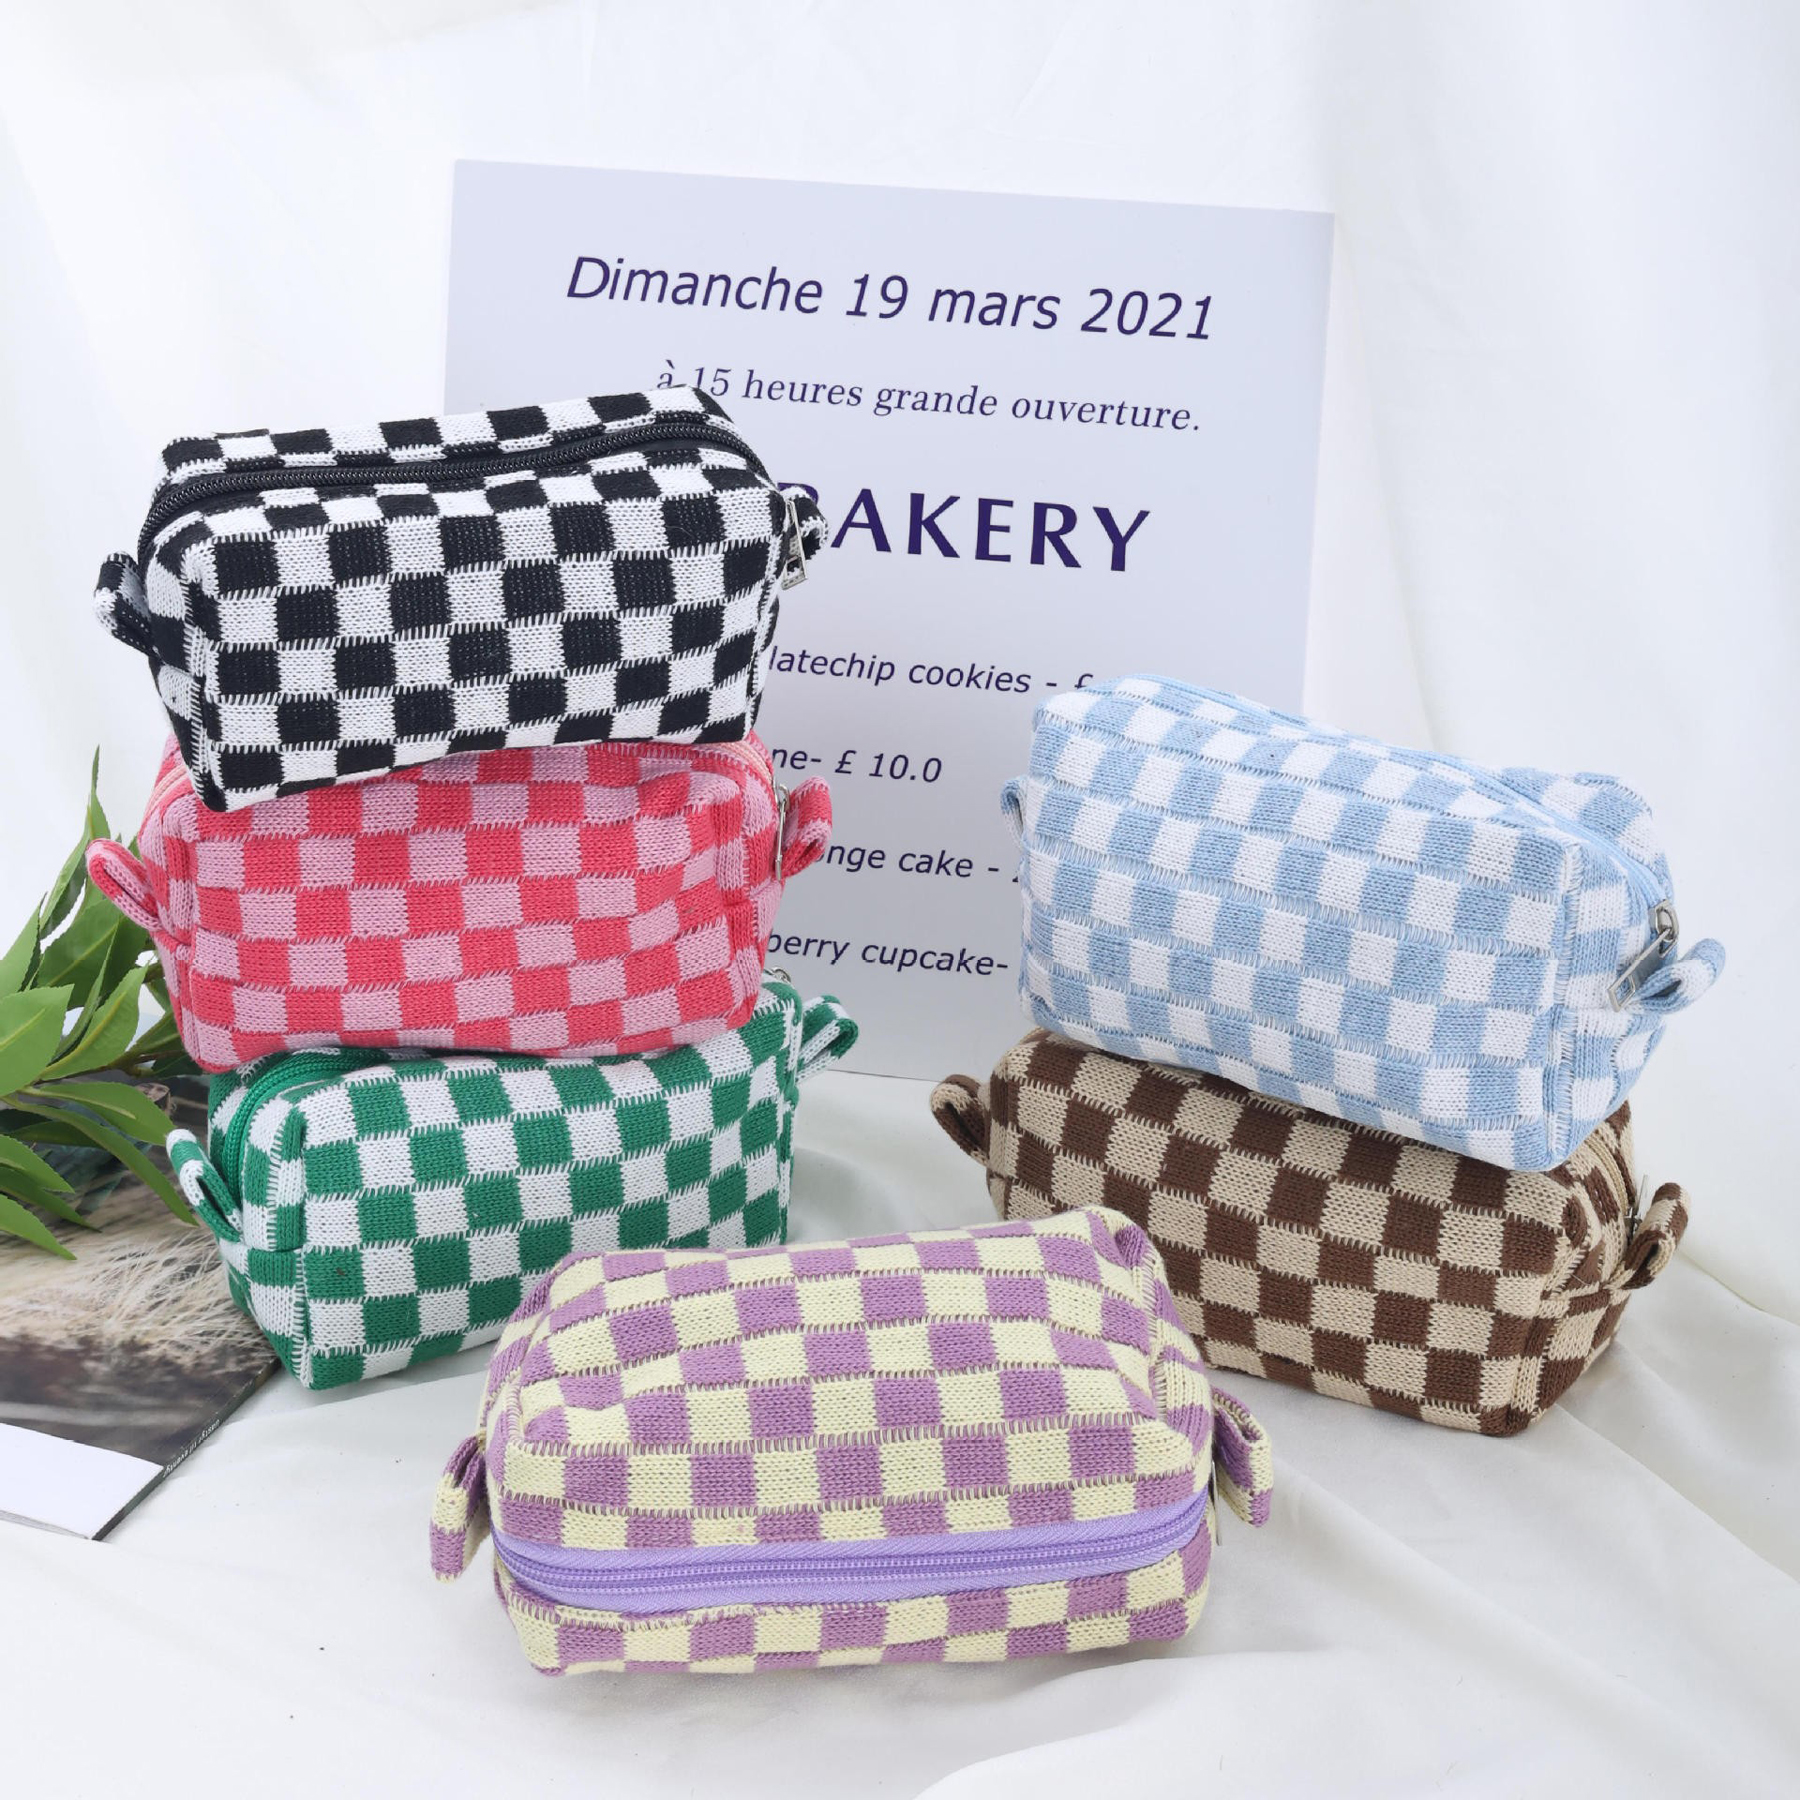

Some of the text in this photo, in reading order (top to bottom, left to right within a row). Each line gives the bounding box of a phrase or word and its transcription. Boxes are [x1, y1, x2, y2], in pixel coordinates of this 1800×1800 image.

[566, 255, 1213, 341] Dimanche 19 mars 2021
[656, 359, 1201, 431] à 15 heures grande ouverture.
[908, 662, 1032, 694] cookies
[834, 749, 858, 775] £
[868, 752, 943, 784] 10.0
[815, 845, 886, 873] nge
[898, 849, 974, 879] cake
[860, 944, 1009, 976] cupcake-
